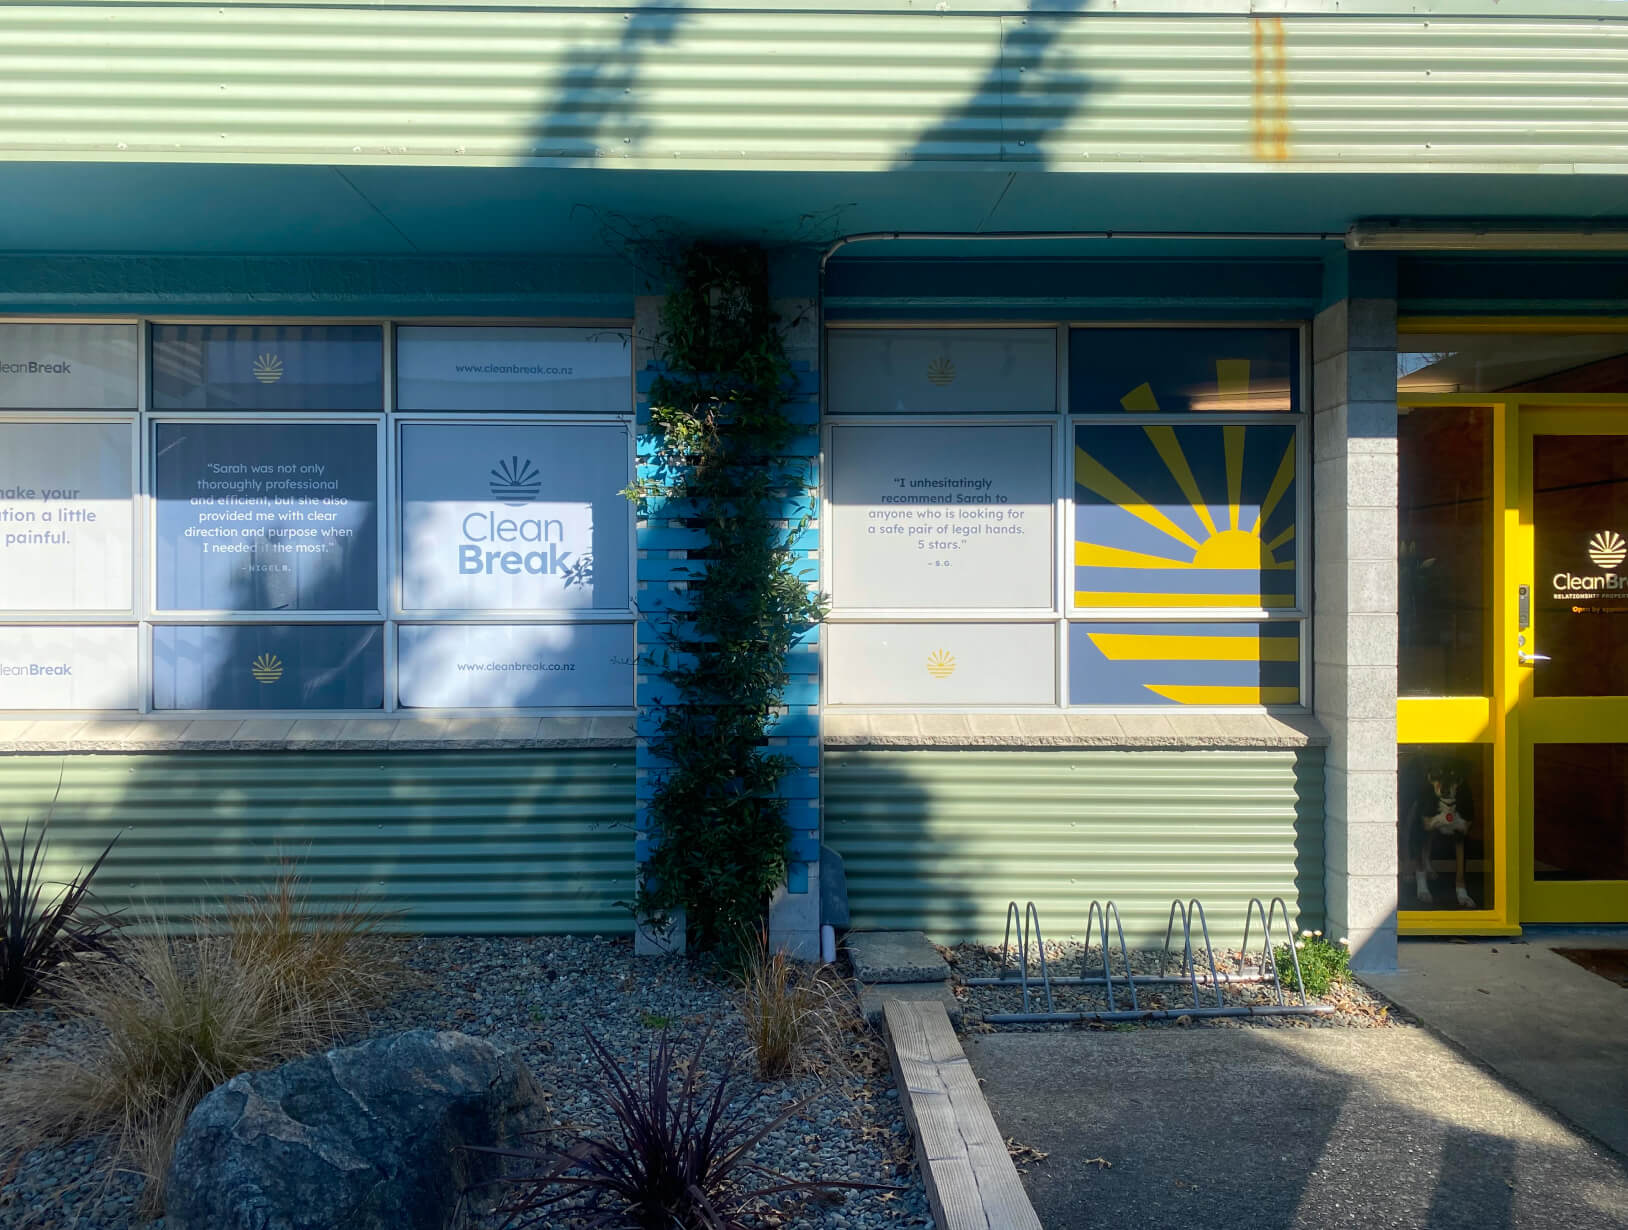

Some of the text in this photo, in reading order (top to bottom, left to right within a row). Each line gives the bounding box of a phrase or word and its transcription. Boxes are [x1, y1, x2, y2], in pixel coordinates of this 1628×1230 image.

[455, 364, 574, 376] www.cleanbreak.co.nz
[251, 465, 274, 474] was
[277, 464, 297, 474] not
[300, 463, 325, 476] only
[197, 479, 339, 492] thoroughly professional
[910, 477, 993, 491] unhesitatingly
[41, 489, 81, 503] your
[190, 495, 348, 508] and efficient, but she also
[881, 493, 1008, 504] recommend Sarah to
[0, 507, 97, 522] tion a little
[199, 510, 337, 524] provided me with clear
[868, 508, 1025, 522] anyone who is looking for
[184, 526, 353, 540] direction and purpose when
[461, 511, 564, 543] Clean
[867, 523, 1025, 537] a safe pair of legal hands.
[5, 529, 71, 548] painful.
[917, 539, 925, 549] 5
[202, 542, 209, 553] I
[212, 541, 257, 553] needed
[271, 541, 293, 553] the
[457, 544, 573, 576] Break
[1553, 572, 1628, 590] CleanBr
[457, 661, 576, 673] www.cleanbreak.co.nz
